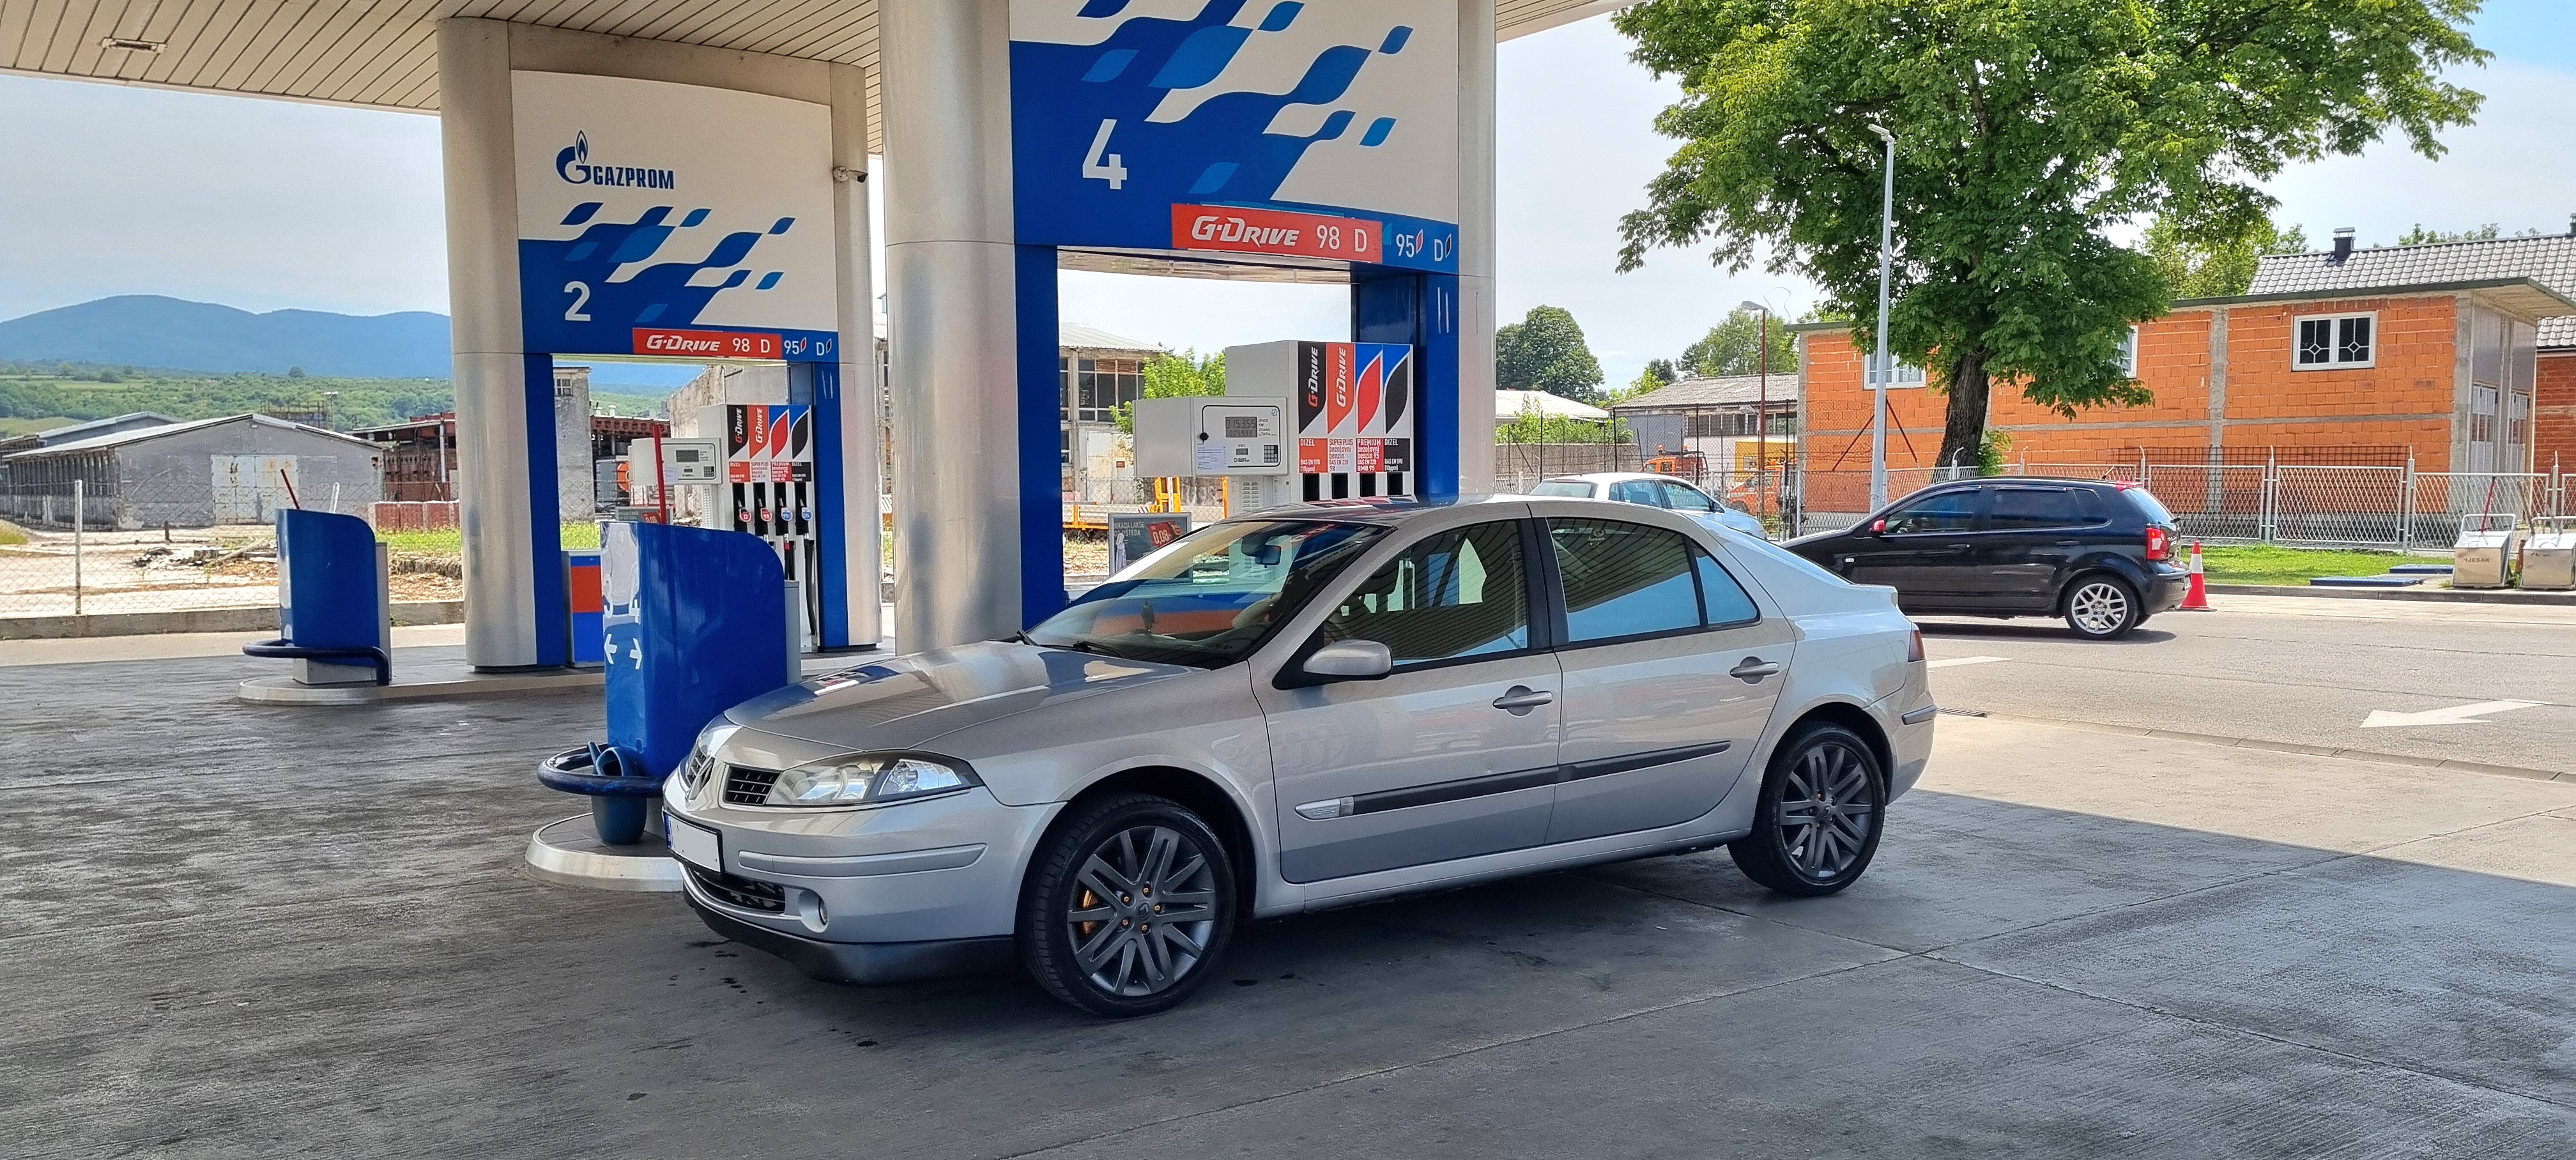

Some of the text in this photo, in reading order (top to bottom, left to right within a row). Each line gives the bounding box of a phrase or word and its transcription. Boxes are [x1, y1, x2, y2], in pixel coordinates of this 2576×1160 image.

[1082, 118, 1128, 190] 4
[593, 165, 675, 190] GAZPROM
[1316, 224, 1340, 250] 98
[1354, 228, 1368, 253] D
[1395, 233, 1414, 258] 95
[1434, 239, 1444, 262] D
[564, 280, 592, 322] 2
[732, 337, 751, 353] 98
[760, 339, 770, 353] D
[783, 339, 799, 355] 95
[816, 342, 825, 356] D
